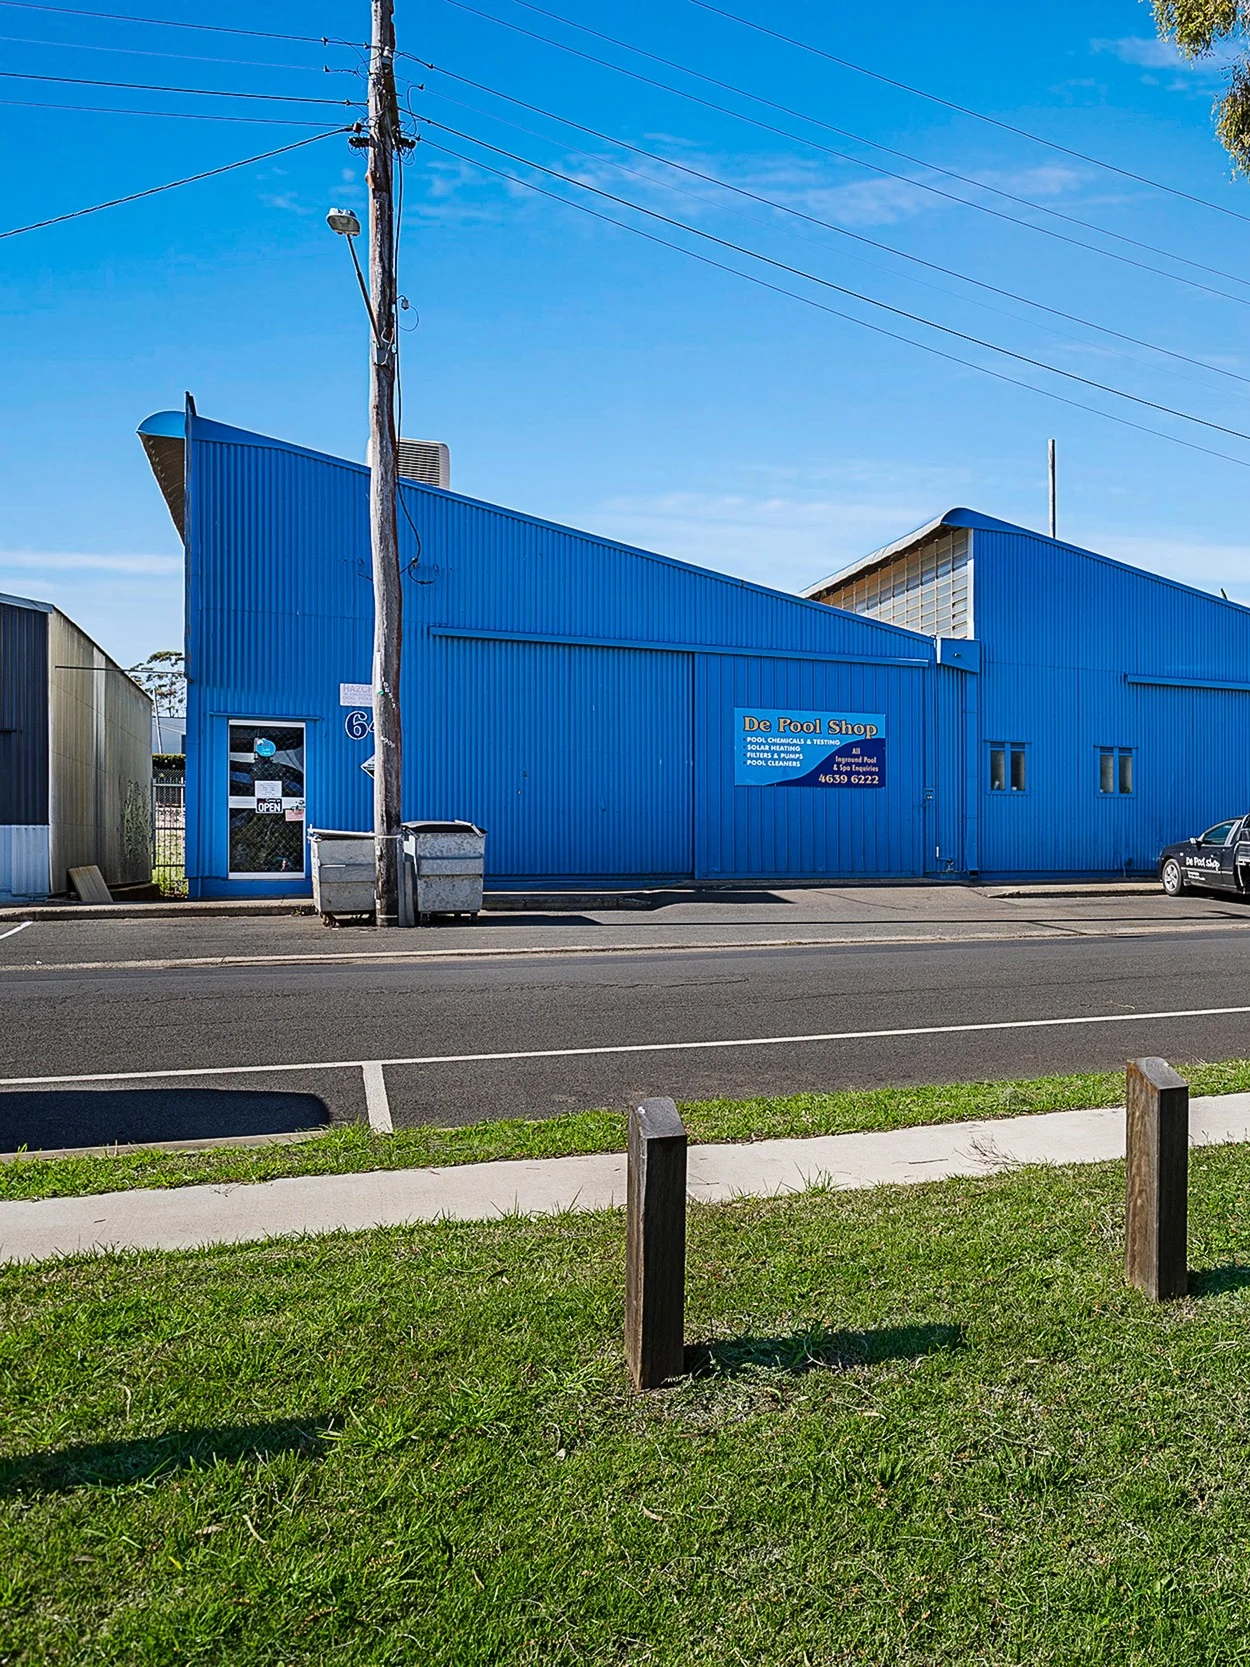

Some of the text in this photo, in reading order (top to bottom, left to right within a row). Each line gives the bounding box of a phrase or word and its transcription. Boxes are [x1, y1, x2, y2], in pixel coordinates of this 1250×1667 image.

[345, 711, 374, 740] 6
[743, 716, 878, 739] De Pool Shop
[768, 737, 804, 745] CHEMICALS
[852, 747, 861, 755] All
[835, 755, 877, 764] Inground Pool
[839, 764, 851, 772] Spa
[852, 764, 879, 773] Enquiries
[818, 774, 879, 784] 4639 6222
[258, 803, 281, 812] OPEN
